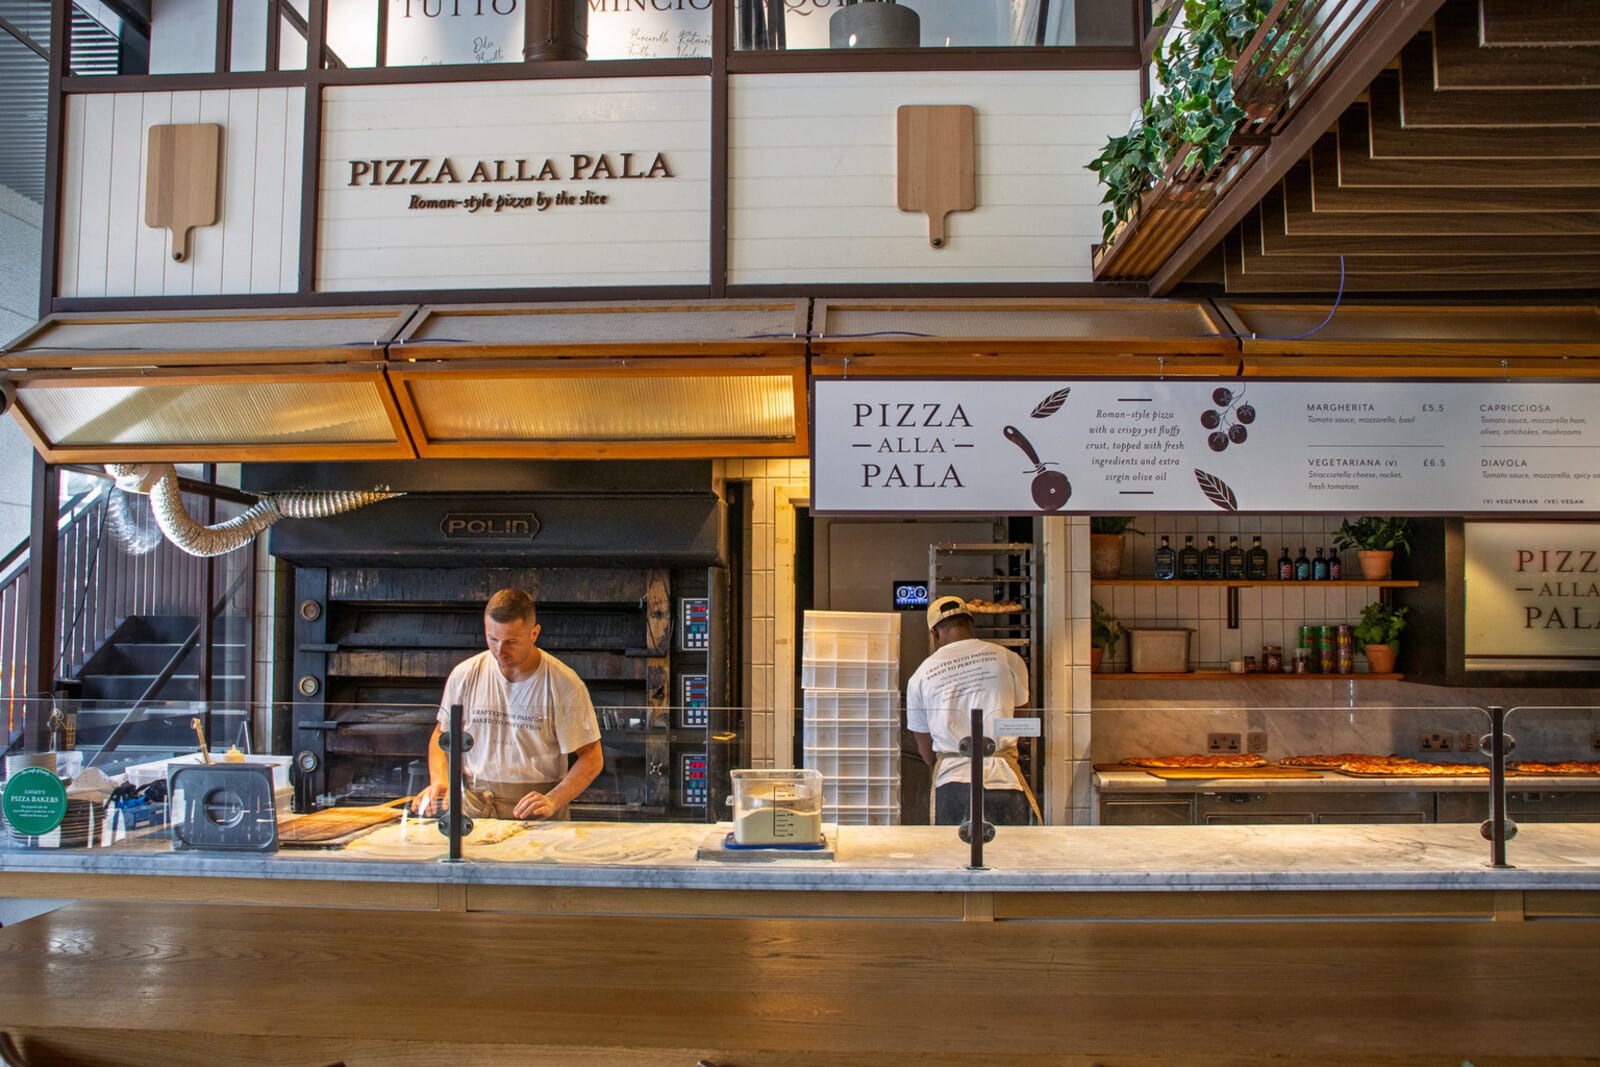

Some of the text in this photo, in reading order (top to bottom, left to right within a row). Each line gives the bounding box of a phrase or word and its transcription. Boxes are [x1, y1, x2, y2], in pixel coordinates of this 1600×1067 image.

[347, 152, 676, 186] PIZZA ALLA PALA
[408, 189, 609, 214] Roman-style pizza by the slice
[1306, 403, 1445, 412] MARGHERITA £5.5
[1480, 404, 1552, 413] CAPRICCIOSA
[853, 403, 974, 428] PIZZA
[1152, 410, 1174, 421] pizza
[1308, 415, 1416, 424] Tomato sauce, mozzarella, basil
[1480, 416, 1506, 424] Tomato
[1507, 417, 1530, 425] sauce,
[1089, 425, 1107, 434] with
[1117, 426, 1141, 437] crispy
[1141, 426, 1157, 437] yet
[1159, 425, 1180, 437] fluffy
[1479, 428, 1582, 436] olives, artichokes, mushrooms
[877, 437, 947, 453] ALLA
[1086, 441, 1185, 452] crust, topped with fresh
[1091, 456, 1180, 468] ingredients and extra
[1307, 458, 1381, 467] VEGETARIANA
[1423, 458, 1446, 467] £6.5
[1481, 459, 1527, 467] DIAVOLA
[861, 463, 966, 488] PALA
[1105, 472, 1167, 484] virgin olive oil
[1308, 471, 1403, 480] Stracciatella cheese, rocket,
[1482, 470, 1508, 479] Tomato
[1509, 472, 1531, 480] sauce,
[1532, 471, 1572, 480] mozzarella,
[1573, 472, 1591, 480] spicy
[1308, 482, 1360, 490] fresh tomatoes
[448, 520, 529, 534] POLIN
[1538, 581, 1600, 598] ALLA
